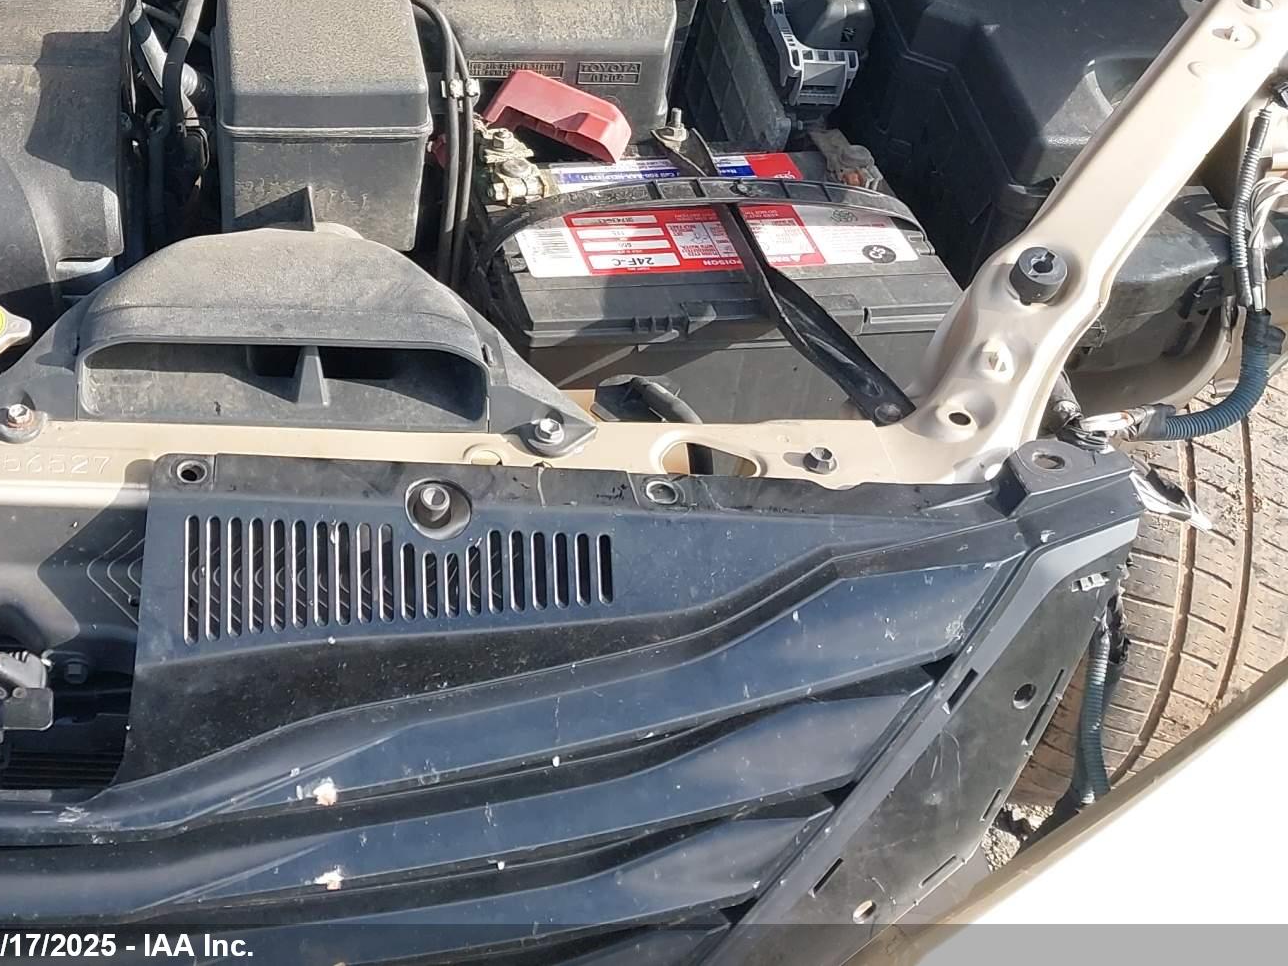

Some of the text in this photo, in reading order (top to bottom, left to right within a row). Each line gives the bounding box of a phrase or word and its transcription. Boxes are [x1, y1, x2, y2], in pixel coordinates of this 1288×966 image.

[581, 63, 639, 72] TOYOTA
[612, 256, 656, 267] 24F-C
[702, 258, 744, 266] POISON
